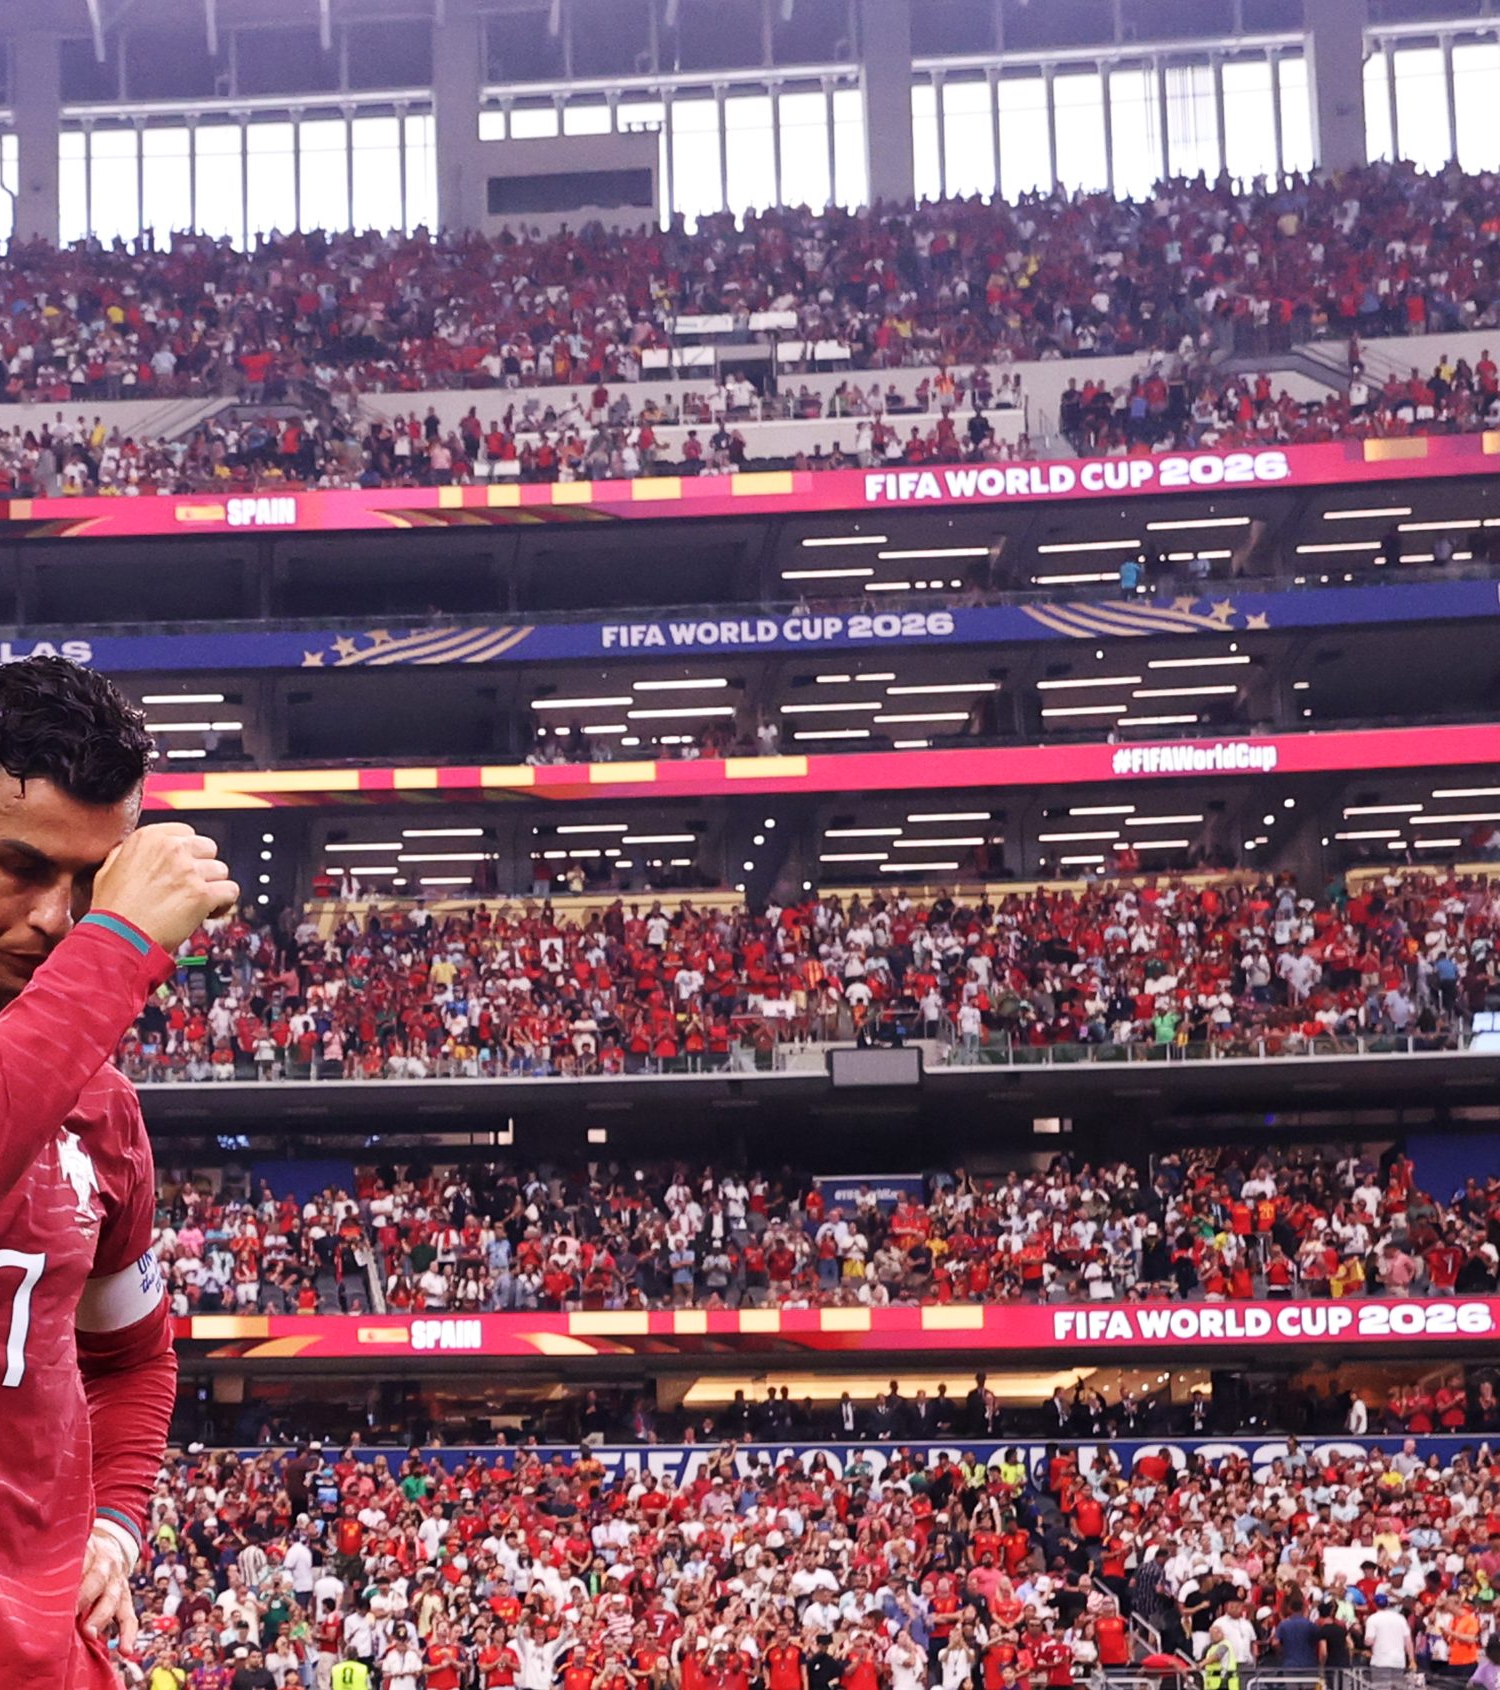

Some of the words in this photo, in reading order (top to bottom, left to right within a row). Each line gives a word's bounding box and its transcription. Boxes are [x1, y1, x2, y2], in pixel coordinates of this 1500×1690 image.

[864, 470, 942, 501] FIFA
[943, 464, 1076, 498] WORLD
[1080, 459, 1155, 492] CUP
[1158, 451, 1288, 487] 2026
[226, 496, 297, 526] SPAIN
[601, 624, 666, 648] FIFA
[668, 619, 778, 645] WORLD
[782, 617, 843, 642] CUP
[847, 612, 955, 639] 2026
[1111, 742, 1278, 773] #FIFAWorldCup
[409, 1319, 482, 1350] SPAIN
[1053, 1309, 1133, 1340] FIFA
[1136, 1307, 1273, 1339] WORLD
[1276, 1304, 1353, 1337] CUP
[1357, 1302, 1492, 1335] 2026
